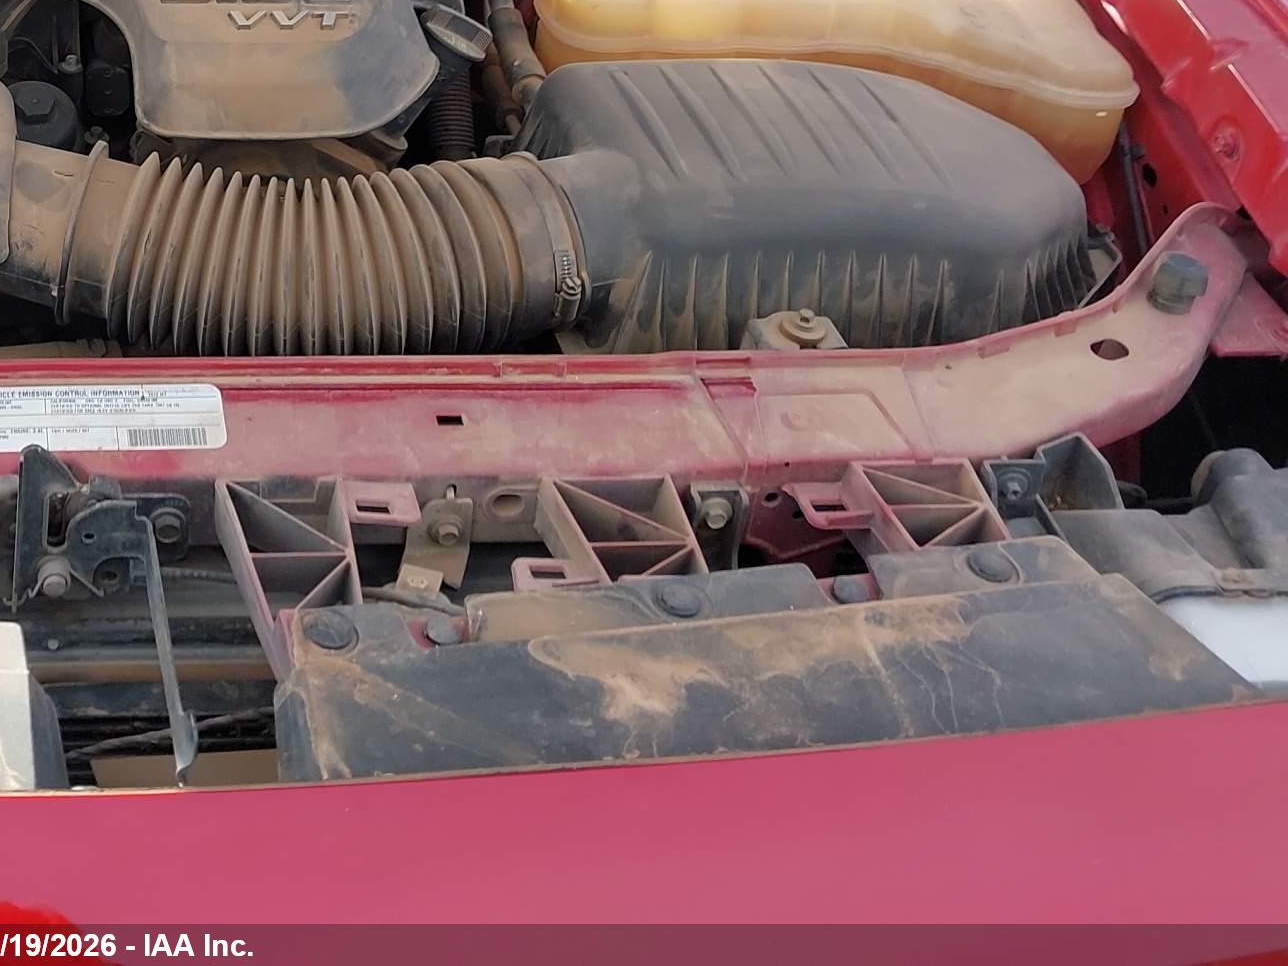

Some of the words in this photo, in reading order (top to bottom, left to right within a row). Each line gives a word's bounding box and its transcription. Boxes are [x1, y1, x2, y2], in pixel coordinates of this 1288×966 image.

[228, 10, 349, 30] VVT
[17, 390, 53, 398] EMISSION
[55, 389, 87, 397] CONTROL
[90, 389, 140, 397] INFORMATION
